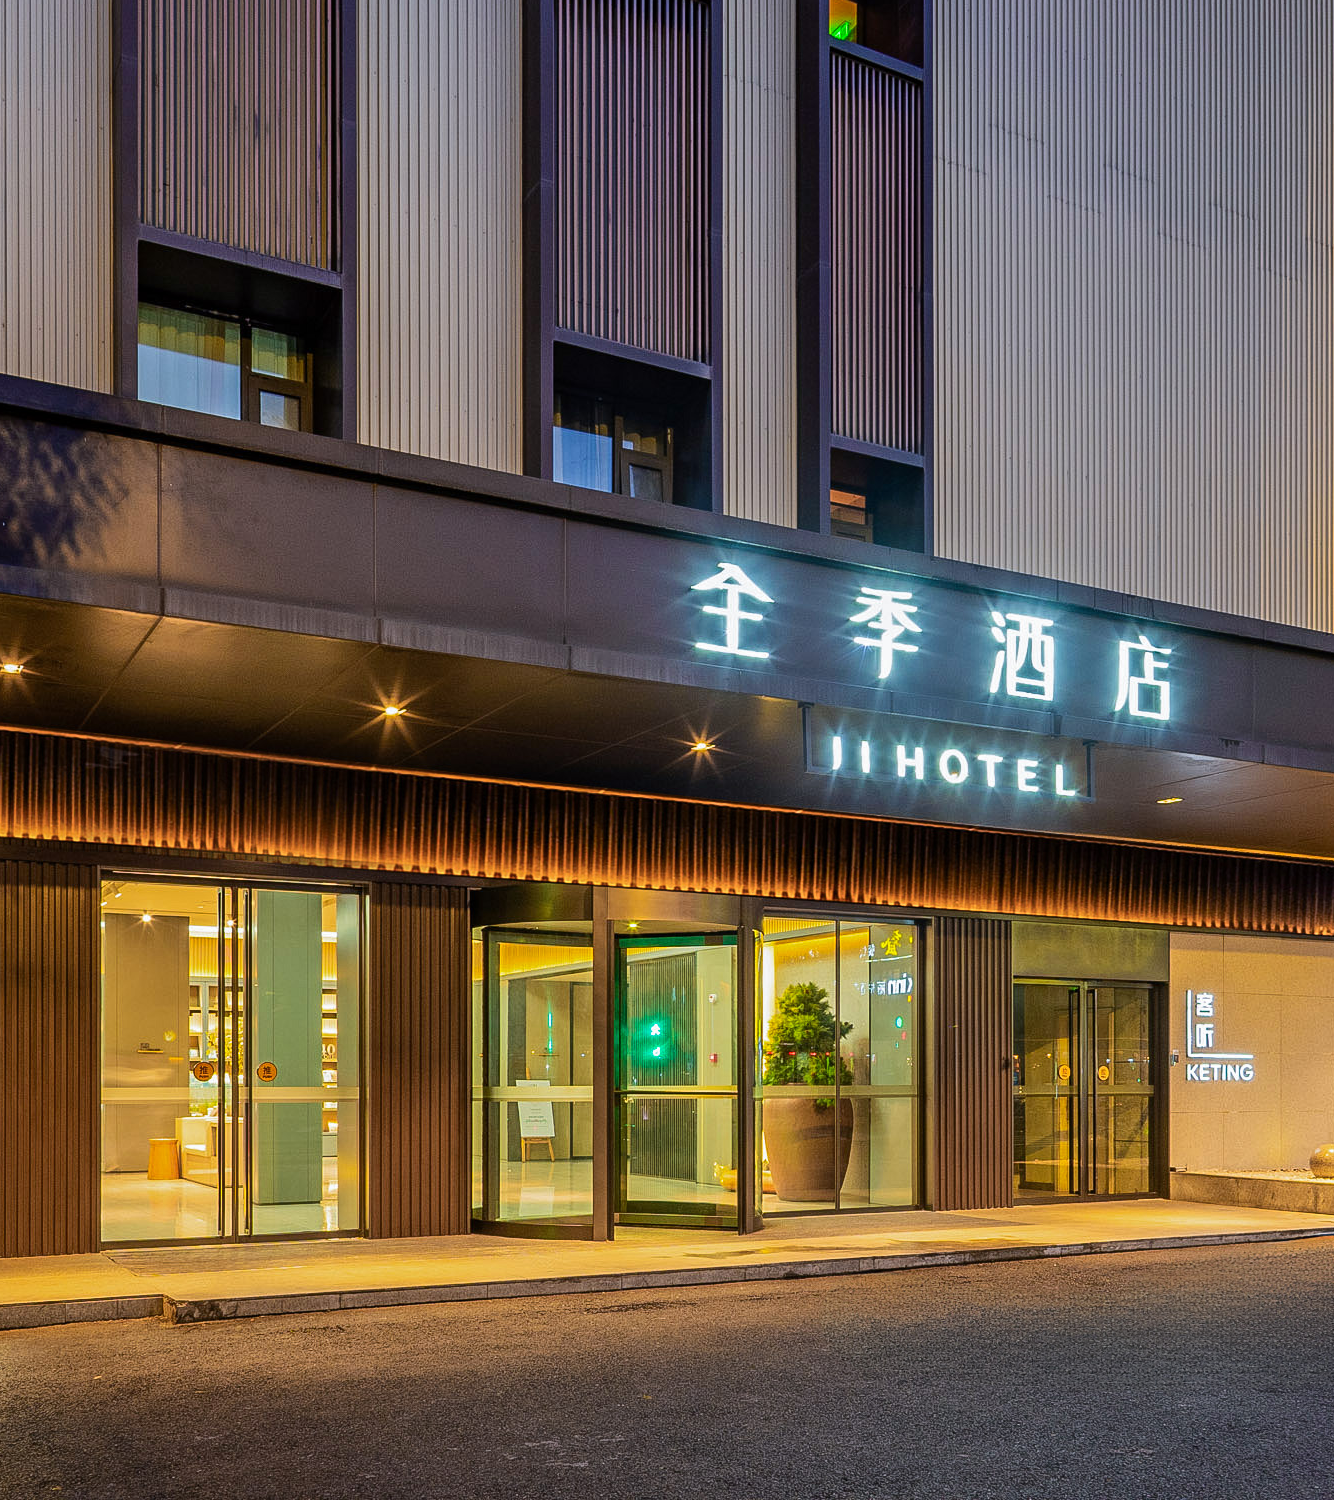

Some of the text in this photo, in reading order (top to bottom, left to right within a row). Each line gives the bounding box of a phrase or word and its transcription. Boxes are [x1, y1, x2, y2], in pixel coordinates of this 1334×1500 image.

[690, 562, 1172, 721] 全季酒店
[831, 735, 1077, 797] JI HOTEL
[1186, 1063, 1255, 1082] KETING
